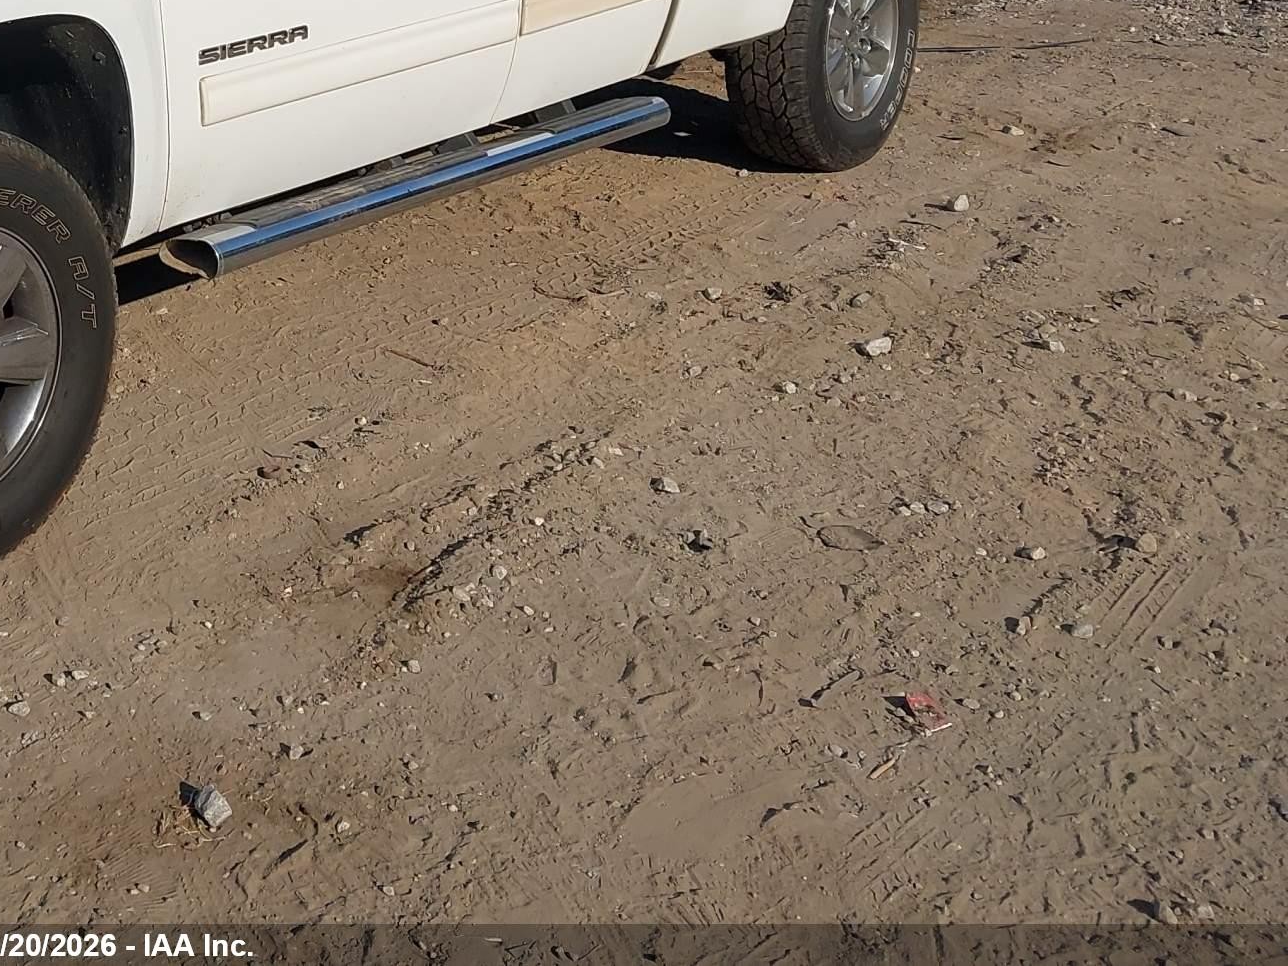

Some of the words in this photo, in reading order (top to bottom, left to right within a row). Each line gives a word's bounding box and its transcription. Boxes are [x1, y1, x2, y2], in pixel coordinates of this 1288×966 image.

[198, 24, 309, 66] SIERRA
[879, 29, 916, 131] COOPER
[68, 256, 97, 329] A/T
